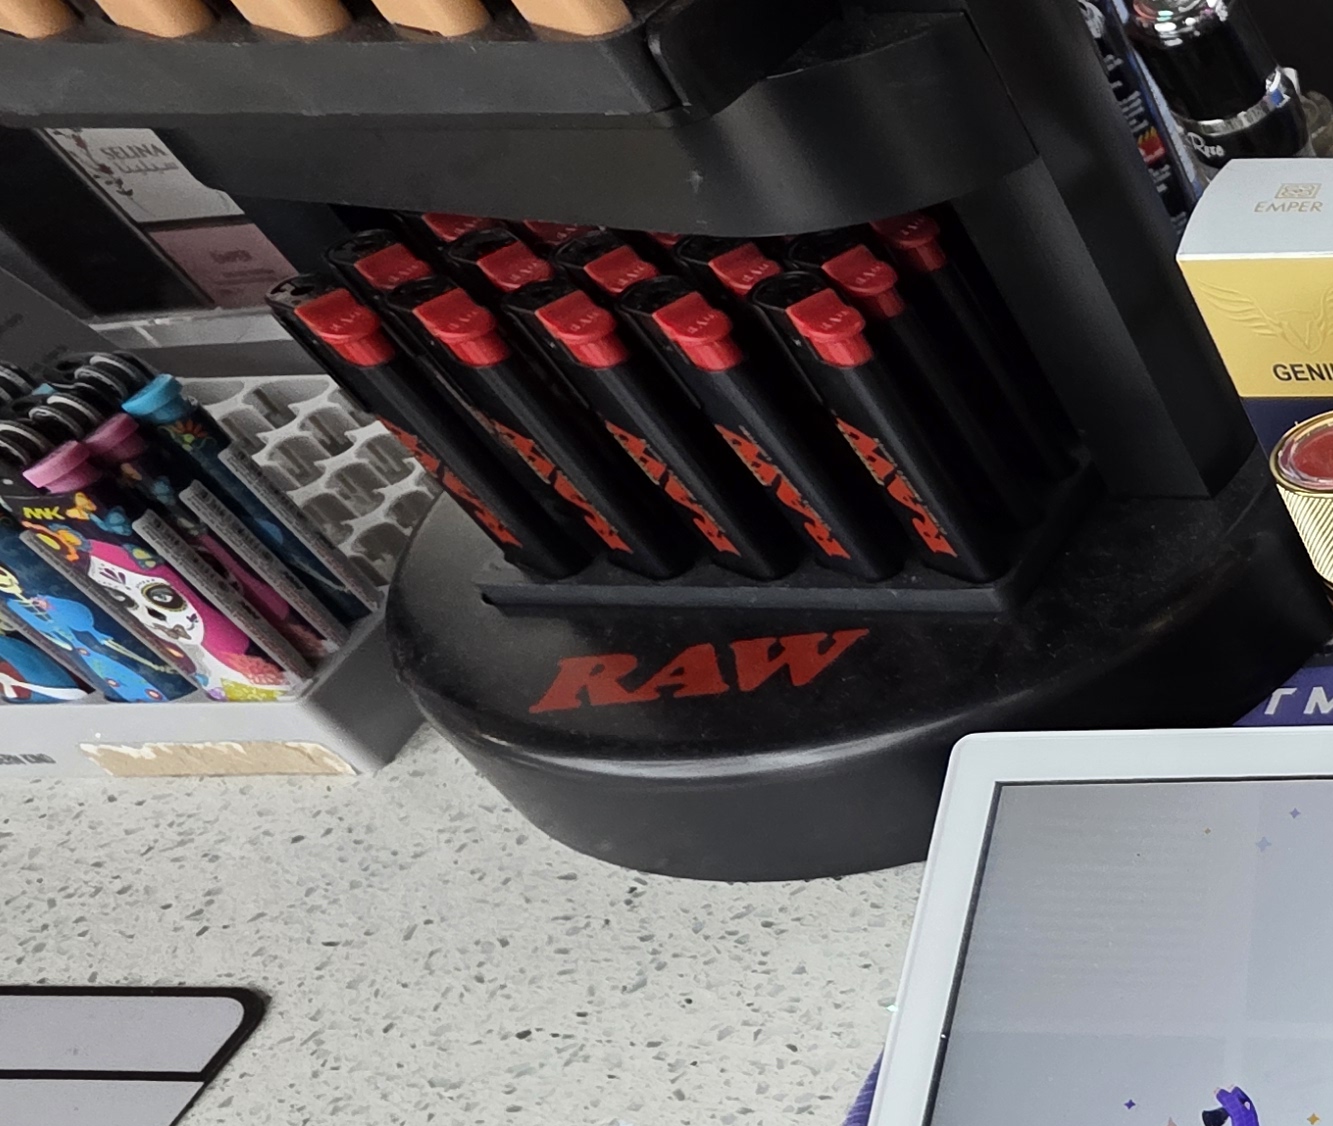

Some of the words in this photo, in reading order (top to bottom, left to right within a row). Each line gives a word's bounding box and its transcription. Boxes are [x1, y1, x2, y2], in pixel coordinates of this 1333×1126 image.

[100, 143, 168, 161] SELINA
[1254, 199, 1323, 215] EMPER
[529, 630, 869, 714] RAW
